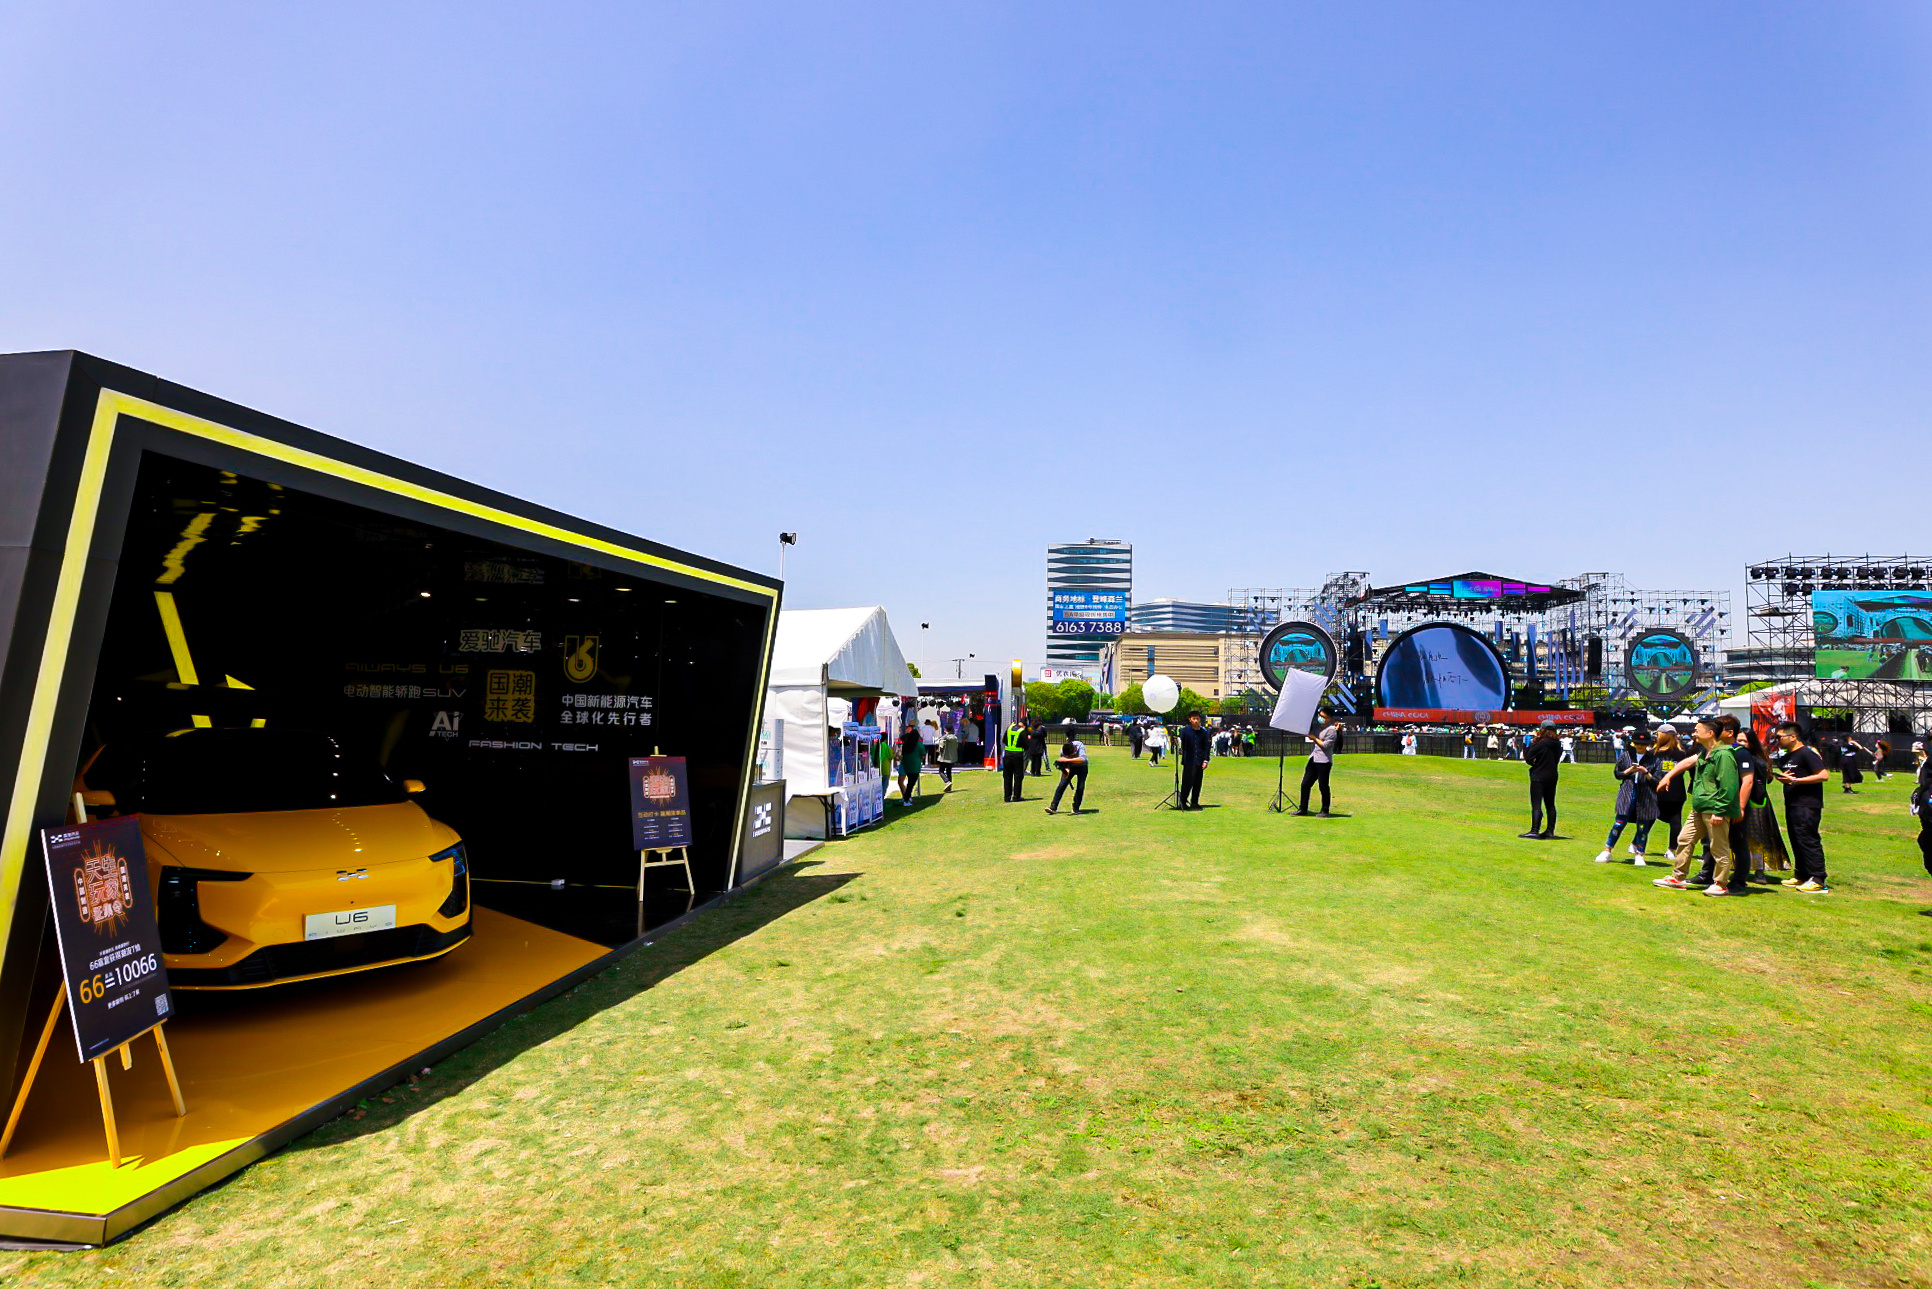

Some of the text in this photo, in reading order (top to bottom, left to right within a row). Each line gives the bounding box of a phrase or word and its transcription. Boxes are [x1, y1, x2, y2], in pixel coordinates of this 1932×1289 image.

[1056, 622, 1122, 633] 6163 7388
[458, 630, 541, 653] 爱驰汽车
[345, 662, 469, 674] AIWAYS U6
[562, 694, 653, 709] 中国新能源汽车
[560, 711, 652, 726] 全球化先行者
[469, 740, 599, 752] FASHION TECH
[335, 911, 369, 925] U6
[79, 974, 105, 1004] 66
[115, 953, 158, 986] 10066
